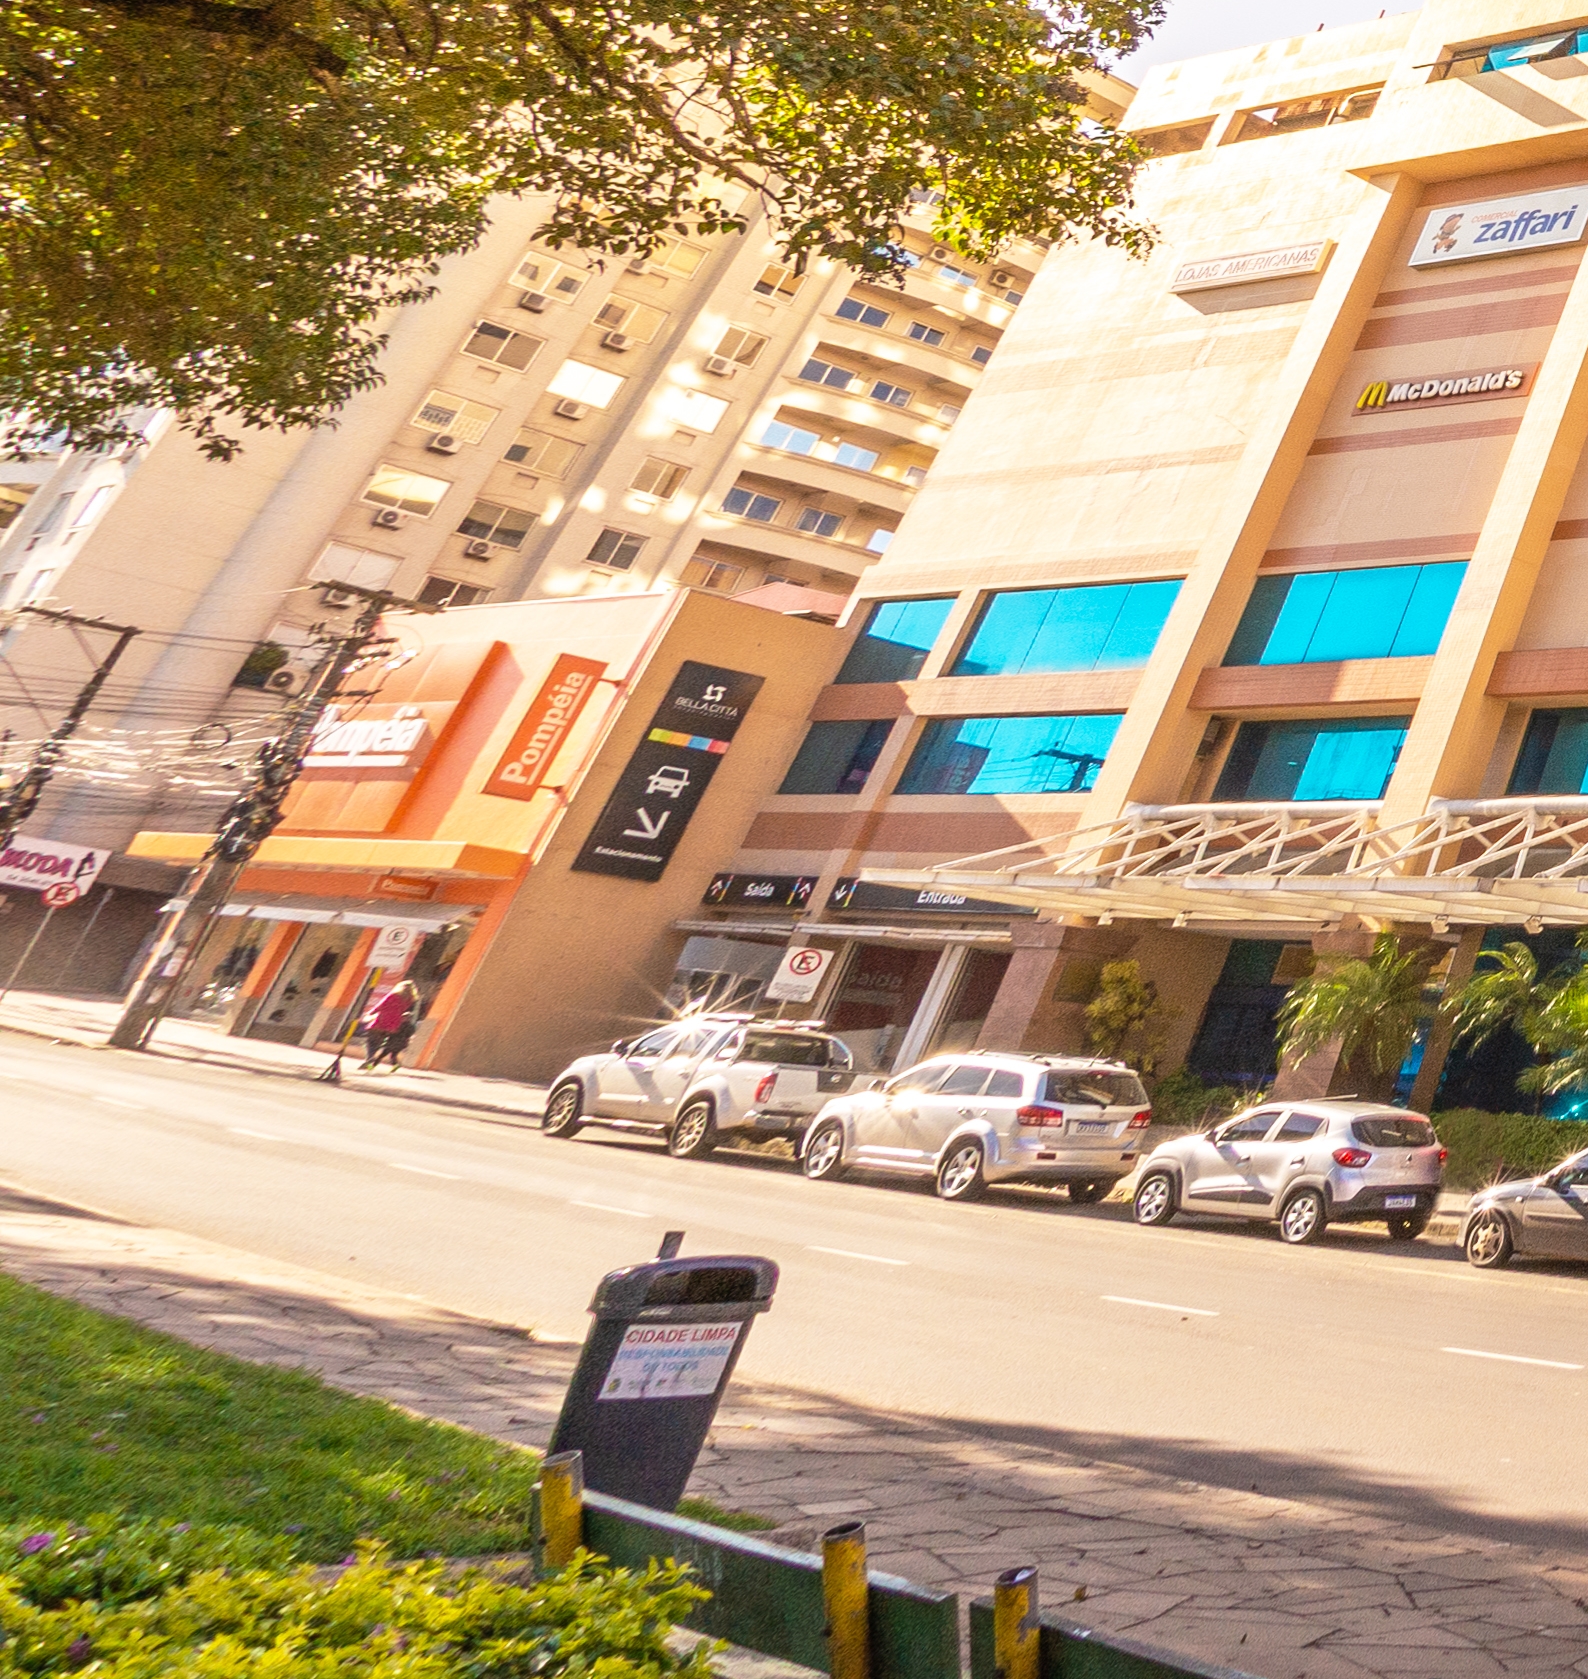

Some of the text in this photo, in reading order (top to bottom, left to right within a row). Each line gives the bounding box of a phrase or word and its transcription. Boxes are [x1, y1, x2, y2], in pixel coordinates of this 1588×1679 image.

[1471, 209, 1519, 223] COMERCIAL
[1473, 204, 1579, 244] zaffari
[1174, 248, 1320, 283] LOJAS AMERICANAS
[1386, 369, 1523, 403] McDonald's
[500, 671, 588, 785] Pompéia
[593, 845, 664, 863] Estacionamento
[625, 1326, 737, 1344] CIDADE LIMPA
